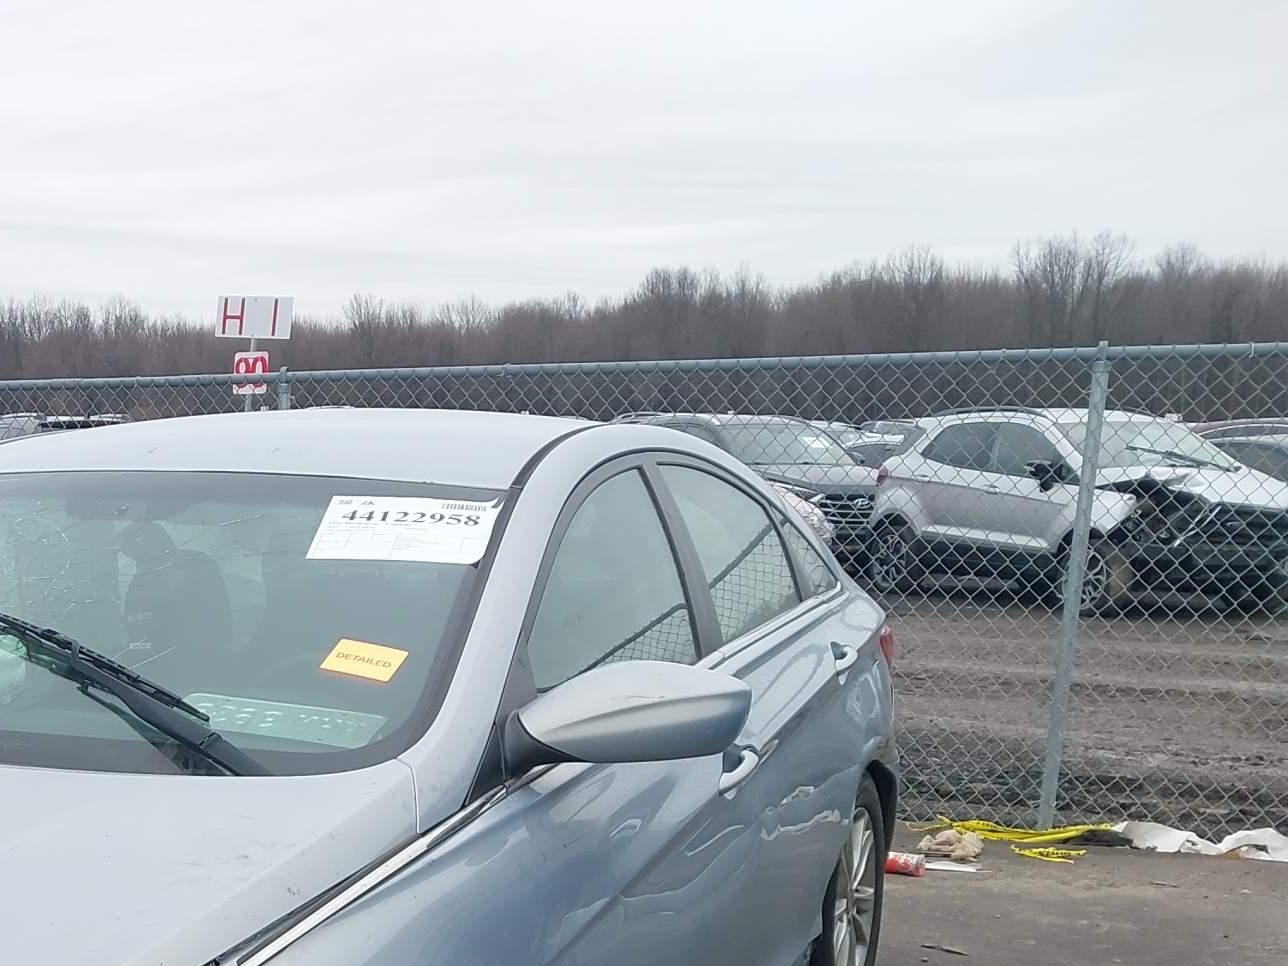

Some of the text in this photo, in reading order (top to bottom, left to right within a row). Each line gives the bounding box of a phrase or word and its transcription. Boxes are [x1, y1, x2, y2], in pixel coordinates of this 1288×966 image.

[221, 297, 246, 336] H
[341, 508, 481, 528] 44122958
[335, 651, 392, 668] DETAILED
